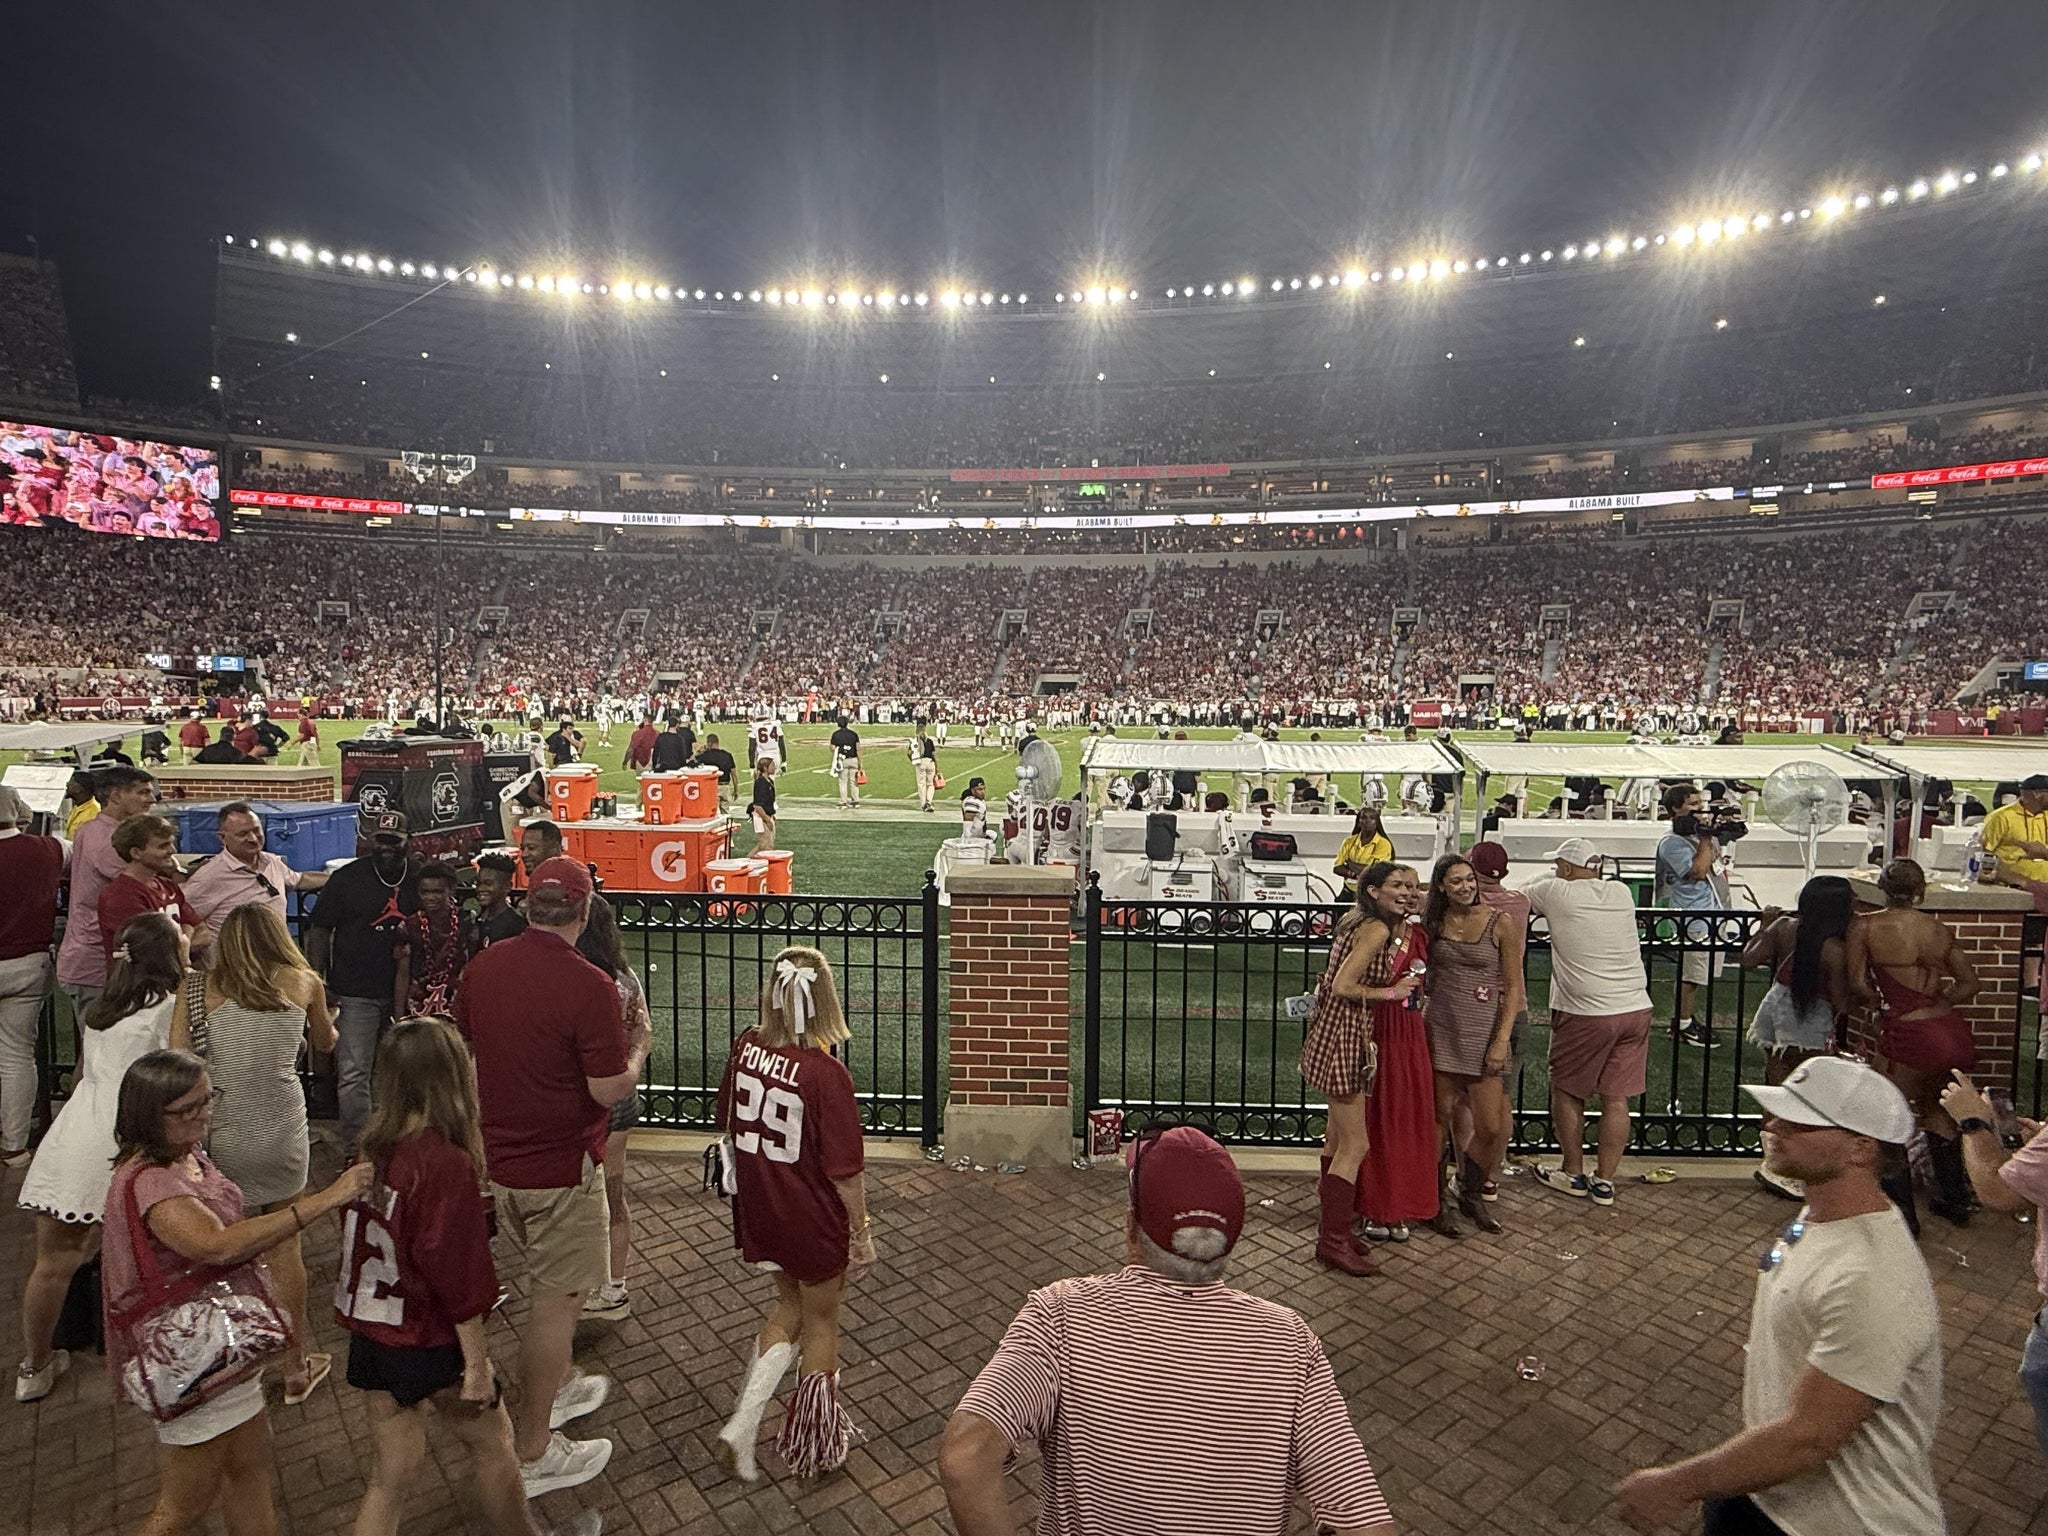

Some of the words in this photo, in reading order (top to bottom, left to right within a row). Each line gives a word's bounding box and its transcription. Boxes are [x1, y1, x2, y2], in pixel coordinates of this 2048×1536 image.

[1569, 498, 1612, 508] ALABAMA
[622, 514, 659, 523] ALABAMA
[758, 726, 778, 743] 64
[554, 781, 570, 799] G
[647, 783, 663, 801] G
[683, 781, 700, 800] G
[1050, 805, 1072, 831] 19
[650, 840, 687, 882] G
[711, 875, 726, 893] G
[739, 1042, 800, 1088] POWELL
[736, 1071, 804, 1164] 29
[334, 1209, 405, 1326] 12
